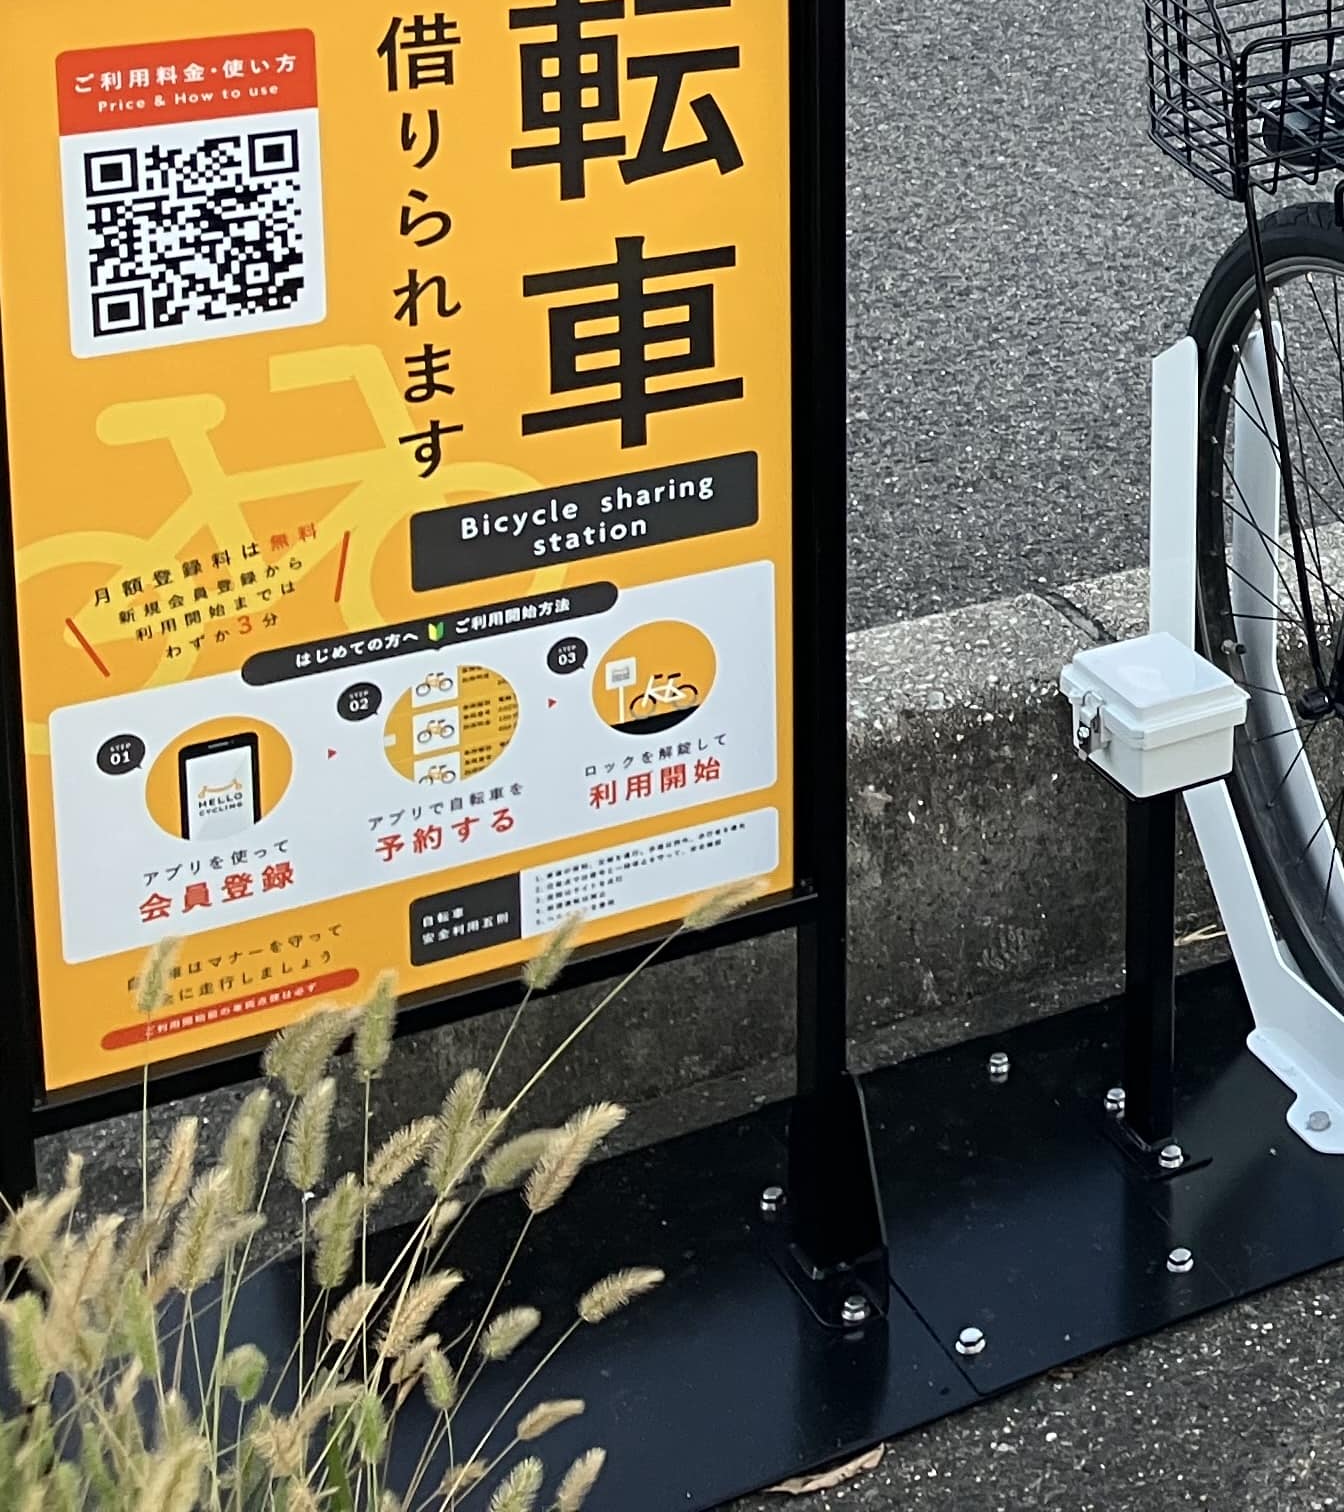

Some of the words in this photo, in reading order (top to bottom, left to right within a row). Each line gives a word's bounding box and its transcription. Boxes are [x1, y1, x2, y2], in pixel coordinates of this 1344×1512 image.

[74, 52, 297, 94] ご利用料金・使い方
[98, 96, 146, 114] Price
[154, 94, 166, 108] &
[174, 90, 213, 106] How
[222, 87, 242, 100] to
[249, 83, 279, 97] use
[377, 13, 464, 479] 借りられます
[461, 498, 579, 541] Bicycle
[600, 476, 714, 514] sharing
[533, 517, 648, 557] station
[135, 580, 296, 642] 利用開始までは
[295, 631, 419, 669] はじめての方へ
[455, 597, 570, 635] ご利用開始方法
[558, 653, 577, 666] 03
[349, 698, 369, 713] 02
[110, 751, 130, 766] 01
[584, 733, 728, 777] ロックを解錠して
[199, 791, 243, 808] HELLO
[589, 756, 721, 809] 利用開始
[368, 782, 524, 832] アプリで自転車を
[375, 807, 515, 862] 予約する
[143, 839, 289, 887] アプリを使って
[139, 861, 294, 923] 会員登録
